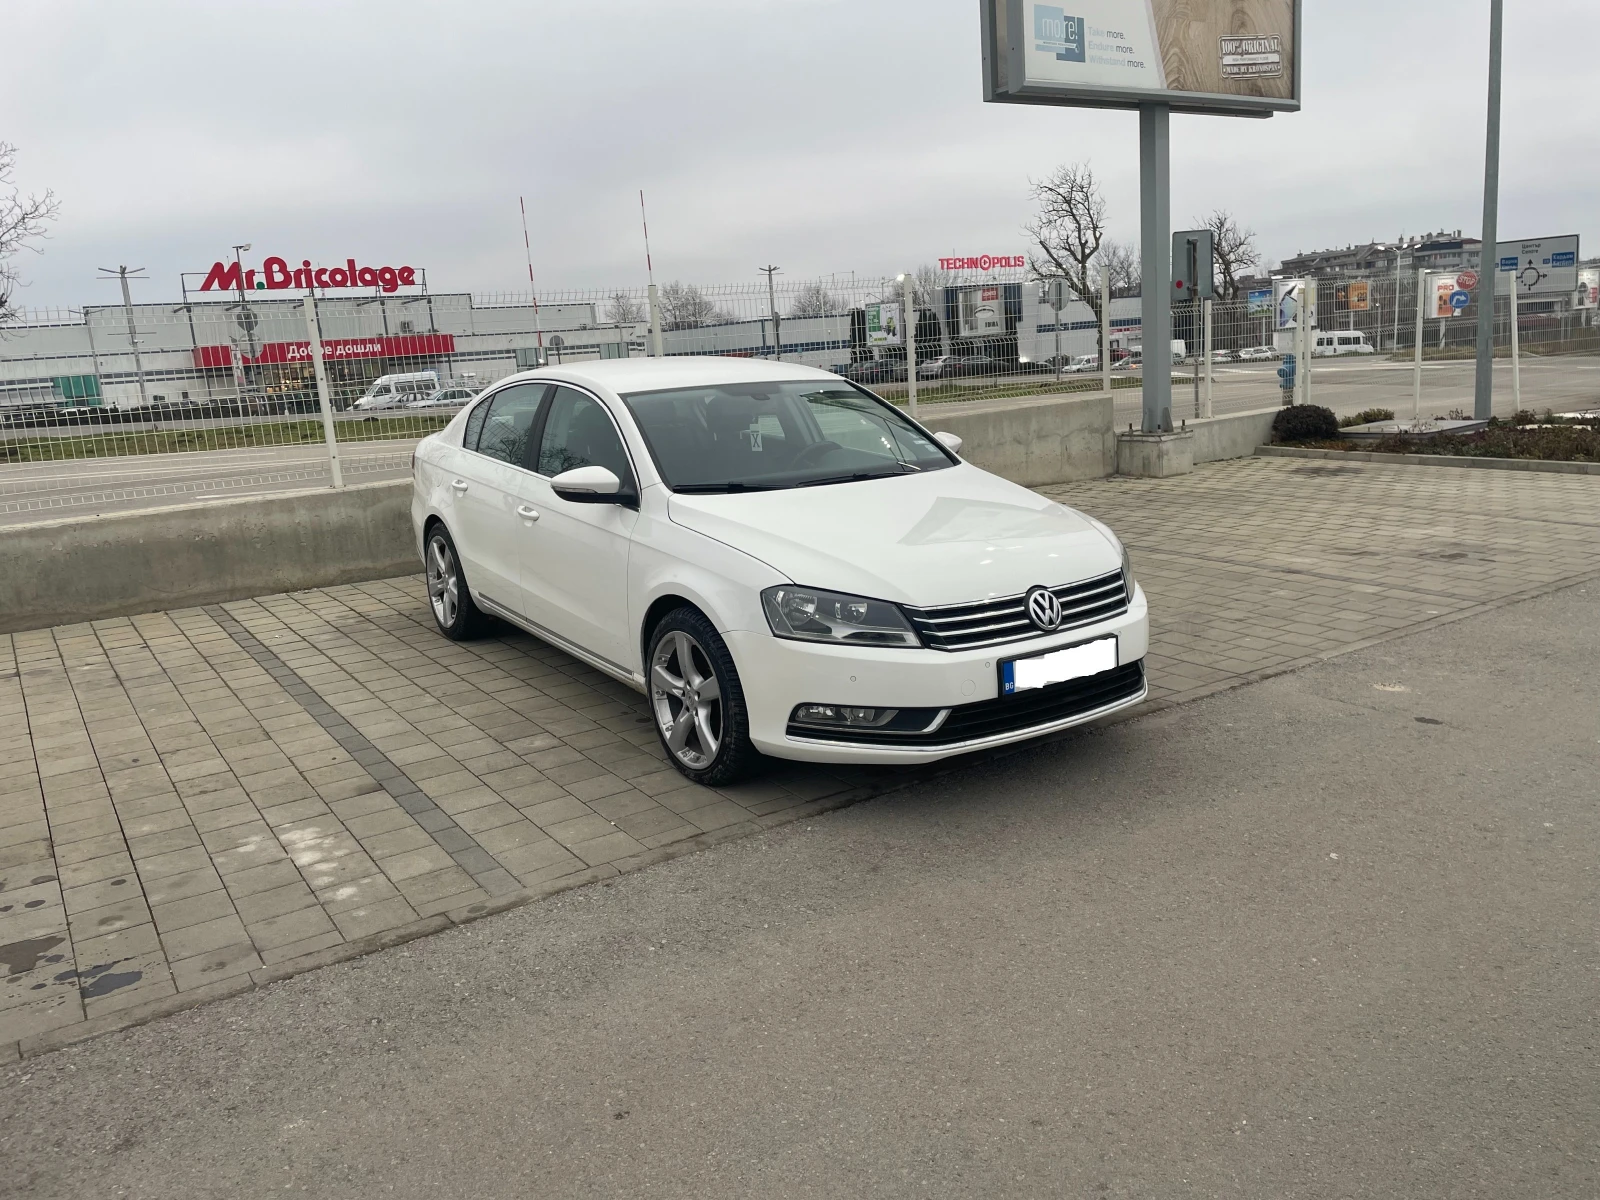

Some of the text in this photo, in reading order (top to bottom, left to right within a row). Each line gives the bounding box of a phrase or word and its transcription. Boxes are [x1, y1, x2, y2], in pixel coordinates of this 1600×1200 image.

[1088, 27, 1126, 40] Take more.
[1088, 41, 1115, 52] Endure
[1115, 44, 1135, 54] more.
[1222, 39, 1279, 54] 100% ORIGINAL
[1089, 54, 1146, 69] Withstand more.
[938, 254, 1025, 271] TECHNOPOLIS
[1458, 275, 1476, 285] STOP
[336, 343, 382, 357] дошли
[1005, 682, 1014, 691] BG
